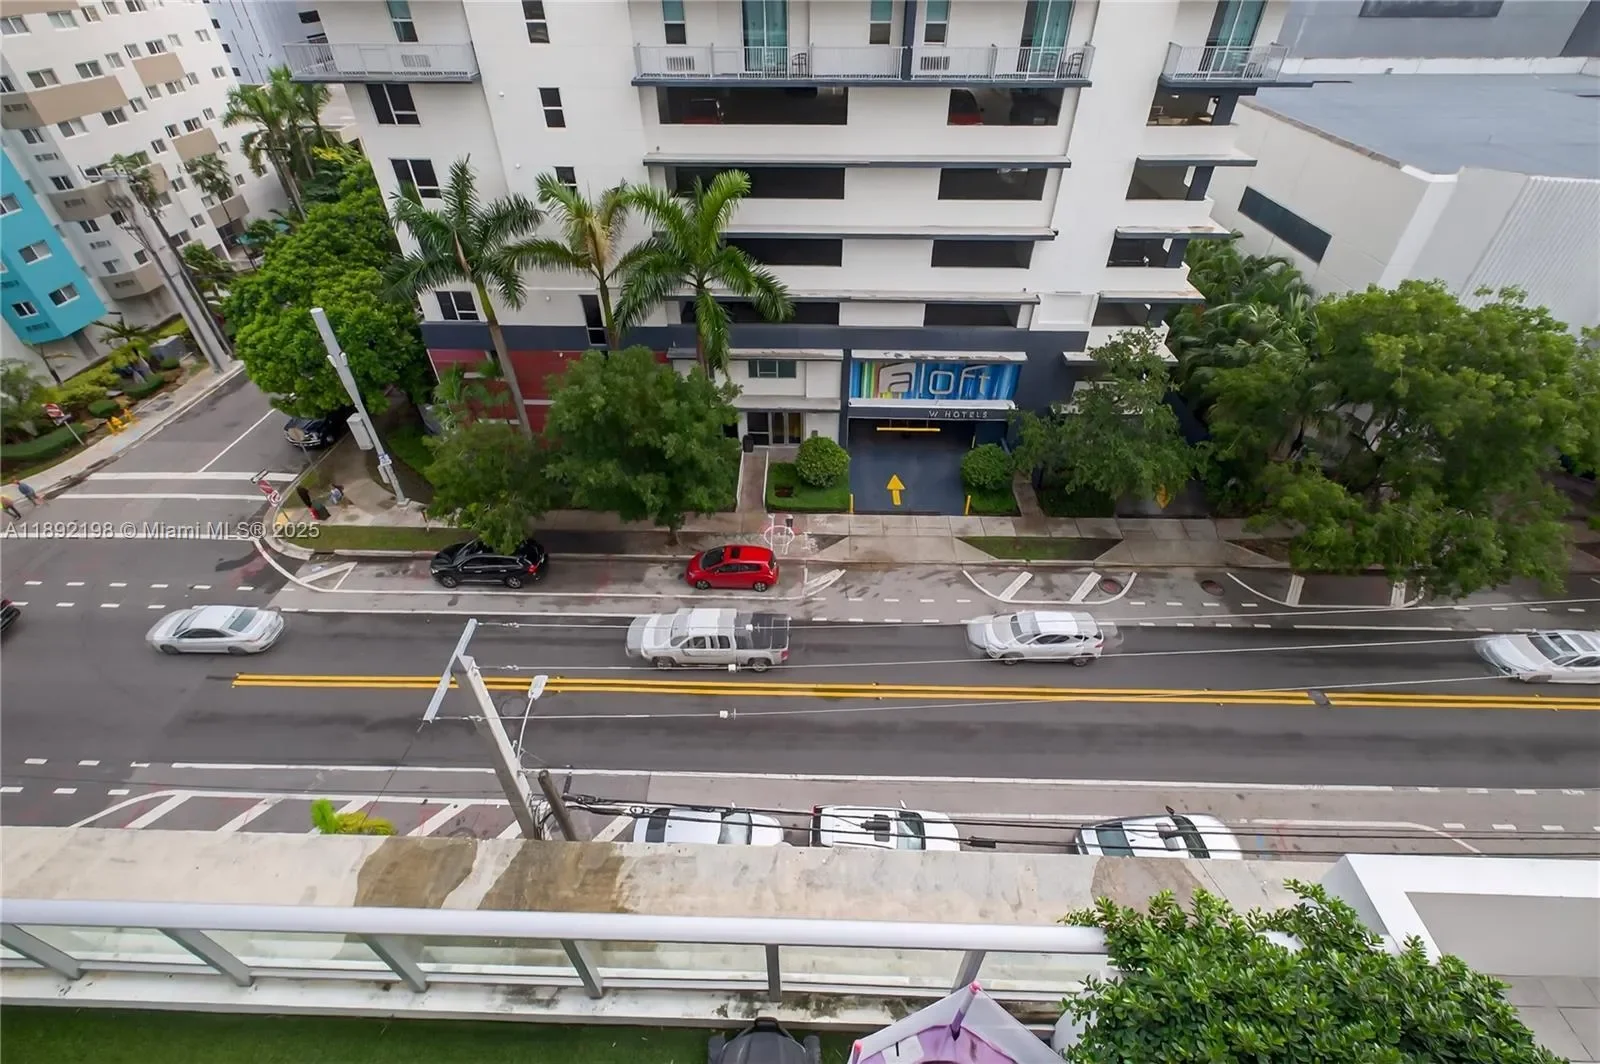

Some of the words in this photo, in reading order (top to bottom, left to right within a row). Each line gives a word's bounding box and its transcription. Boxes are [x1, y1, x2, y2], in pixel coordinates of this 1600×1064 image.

[880, 361, 991, 399] aloft
[928, 410, 939, 418] W
[944, 410, 989, 418] HOTELS
